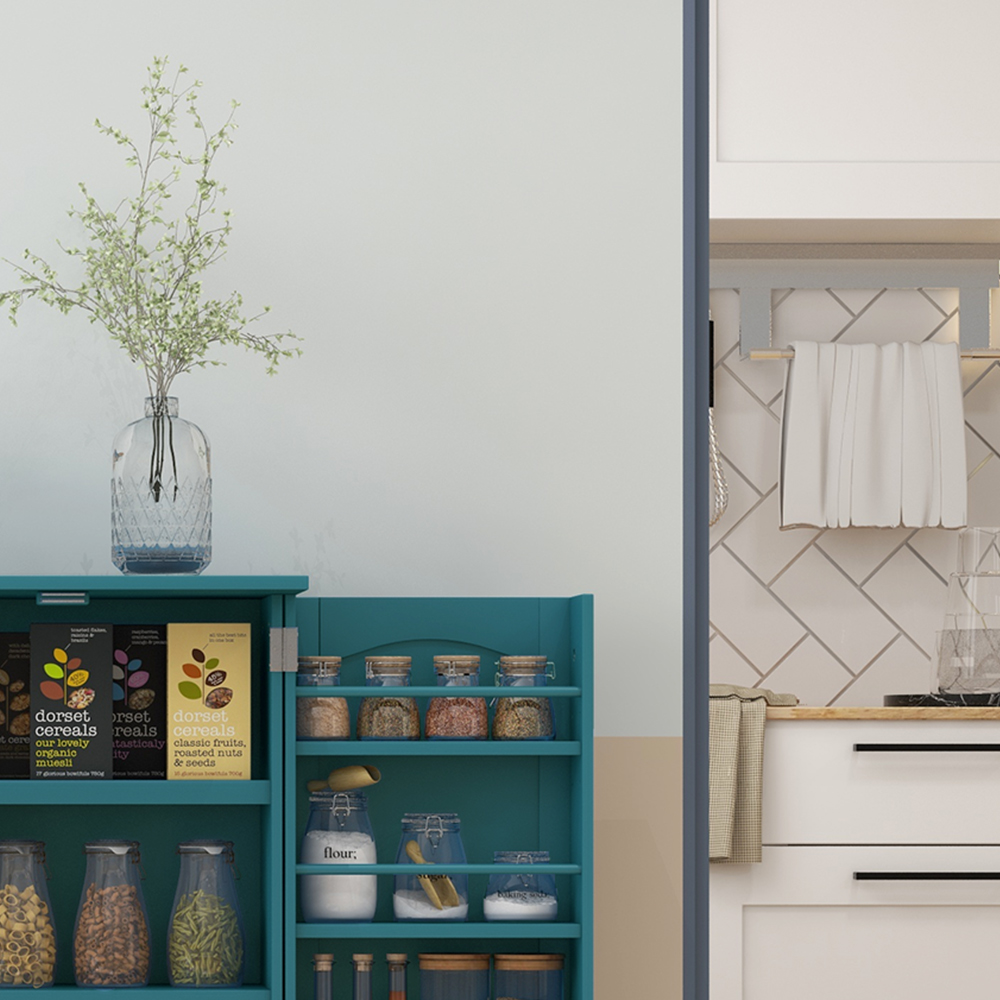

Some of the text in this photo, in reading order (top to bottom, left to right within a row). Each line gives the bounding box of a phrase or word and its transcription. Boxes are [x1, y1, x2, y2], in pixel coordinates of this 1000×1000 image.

[35, 709, 91, 722] dorset
[173, 710, 228, 723] dorset
[35, 724, 97, 737] cereals
[173, 724, 235, 737] cereals
[35, 738, 90, 749] our lovely
[174, 738, 246, 748] classic fruits,
[36, 749, 77, 758] organic
[112, 750, 129, 760] ity
[174, 748, 243, 757] roasted nuts
[36, 758, 73, 767] muesli
[174, 758, 216, 767] & seeds
[497, 889, 527, 899] baking
